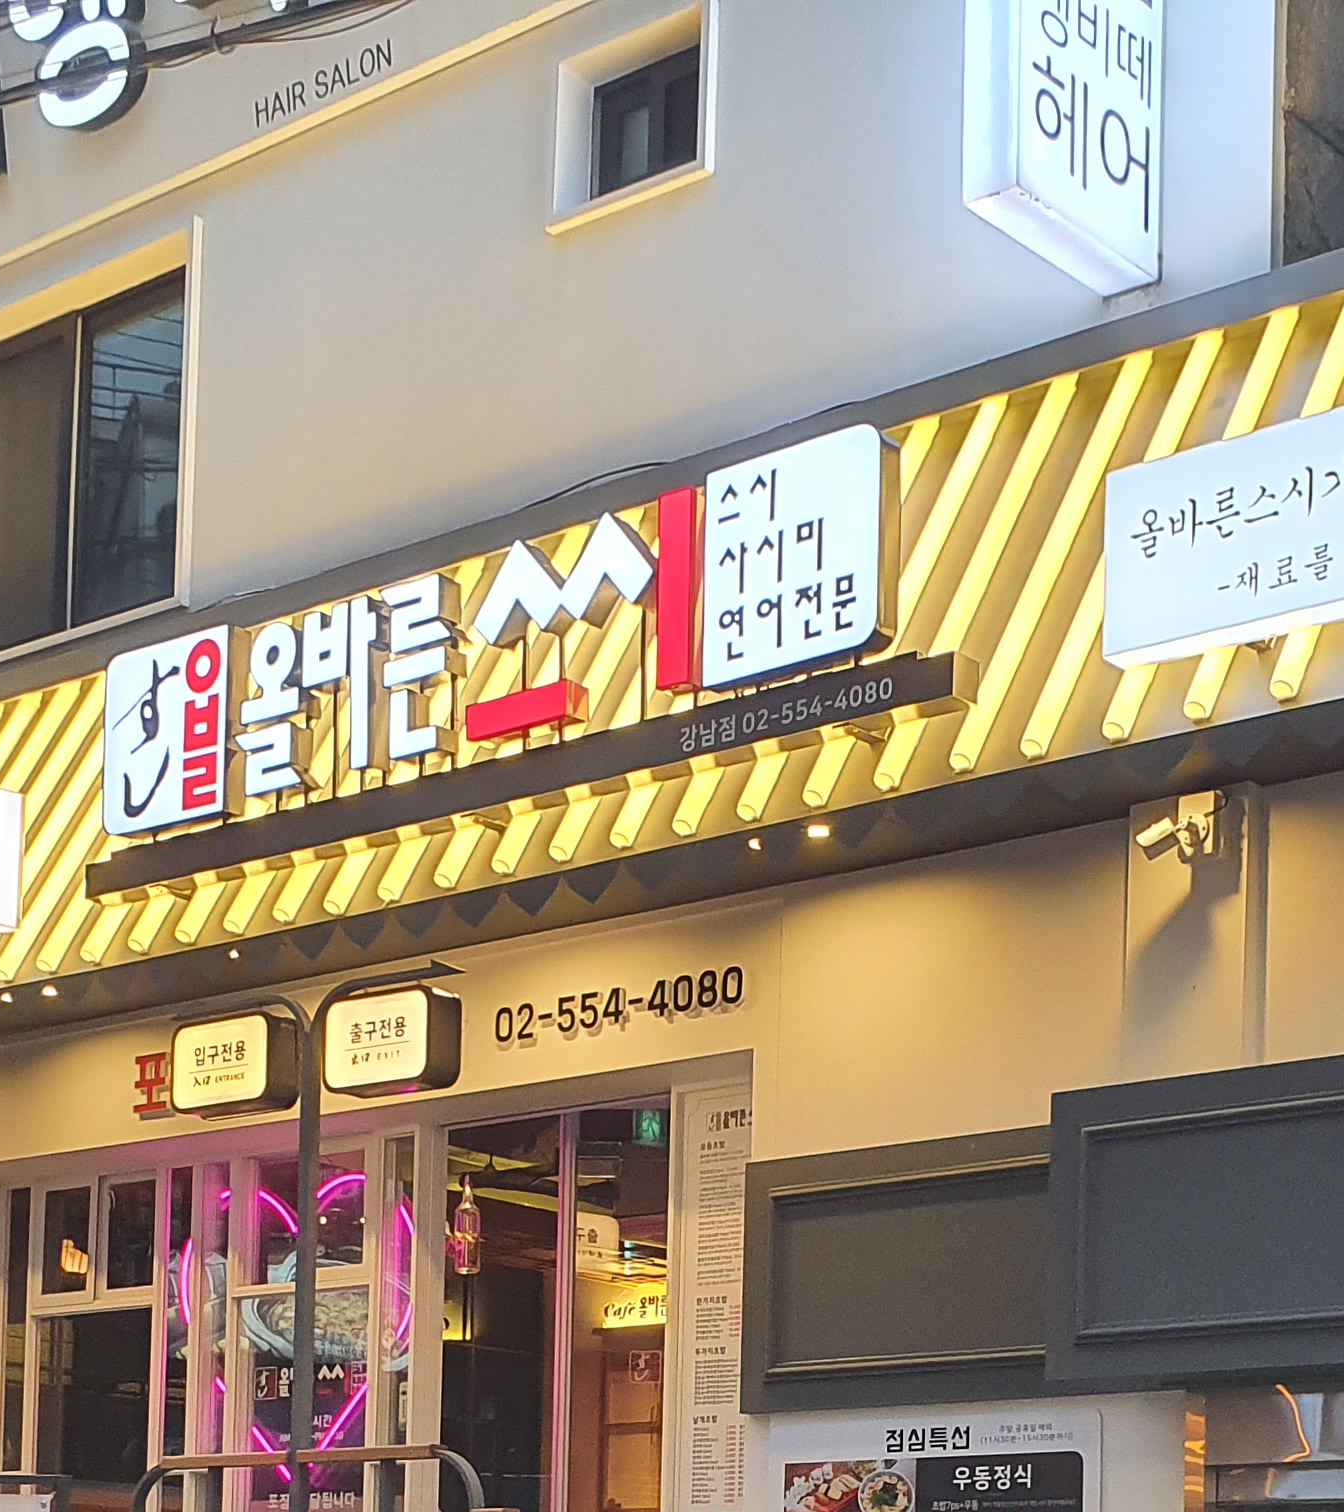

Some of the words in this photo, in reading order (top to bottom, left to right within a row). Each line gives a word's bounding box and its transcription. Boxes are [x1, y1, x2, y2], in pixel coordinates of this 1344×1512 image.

[254, 81, 307, 128] HAIR
[314, 38, 394, 98] SALON
[1032, 55, 1150, 235] 헤어
[717, 467, 778, 526] 스시
[717, 516, 827, 599] 사시미
[717, 572, 859, 662] 연어전문
[239, 572, 451, 798] 올바른
[678, 716, 738, 755] 강남점
[741, 677, 896, 738] 02-554-4080
[349, 1016, 407, 1044] 출구전용
[494, 966, 744, 1044] 02-554-4080
[194, 1040, 247, 1067] 입구전용
[214, 1072, 246, 1084] ENTRANCE
[377, 1050, 401, 1061] EXIT
[885, 1425, 972, 1453] 점심특선
[951, 1463, 1034, 1491] 우동정식
